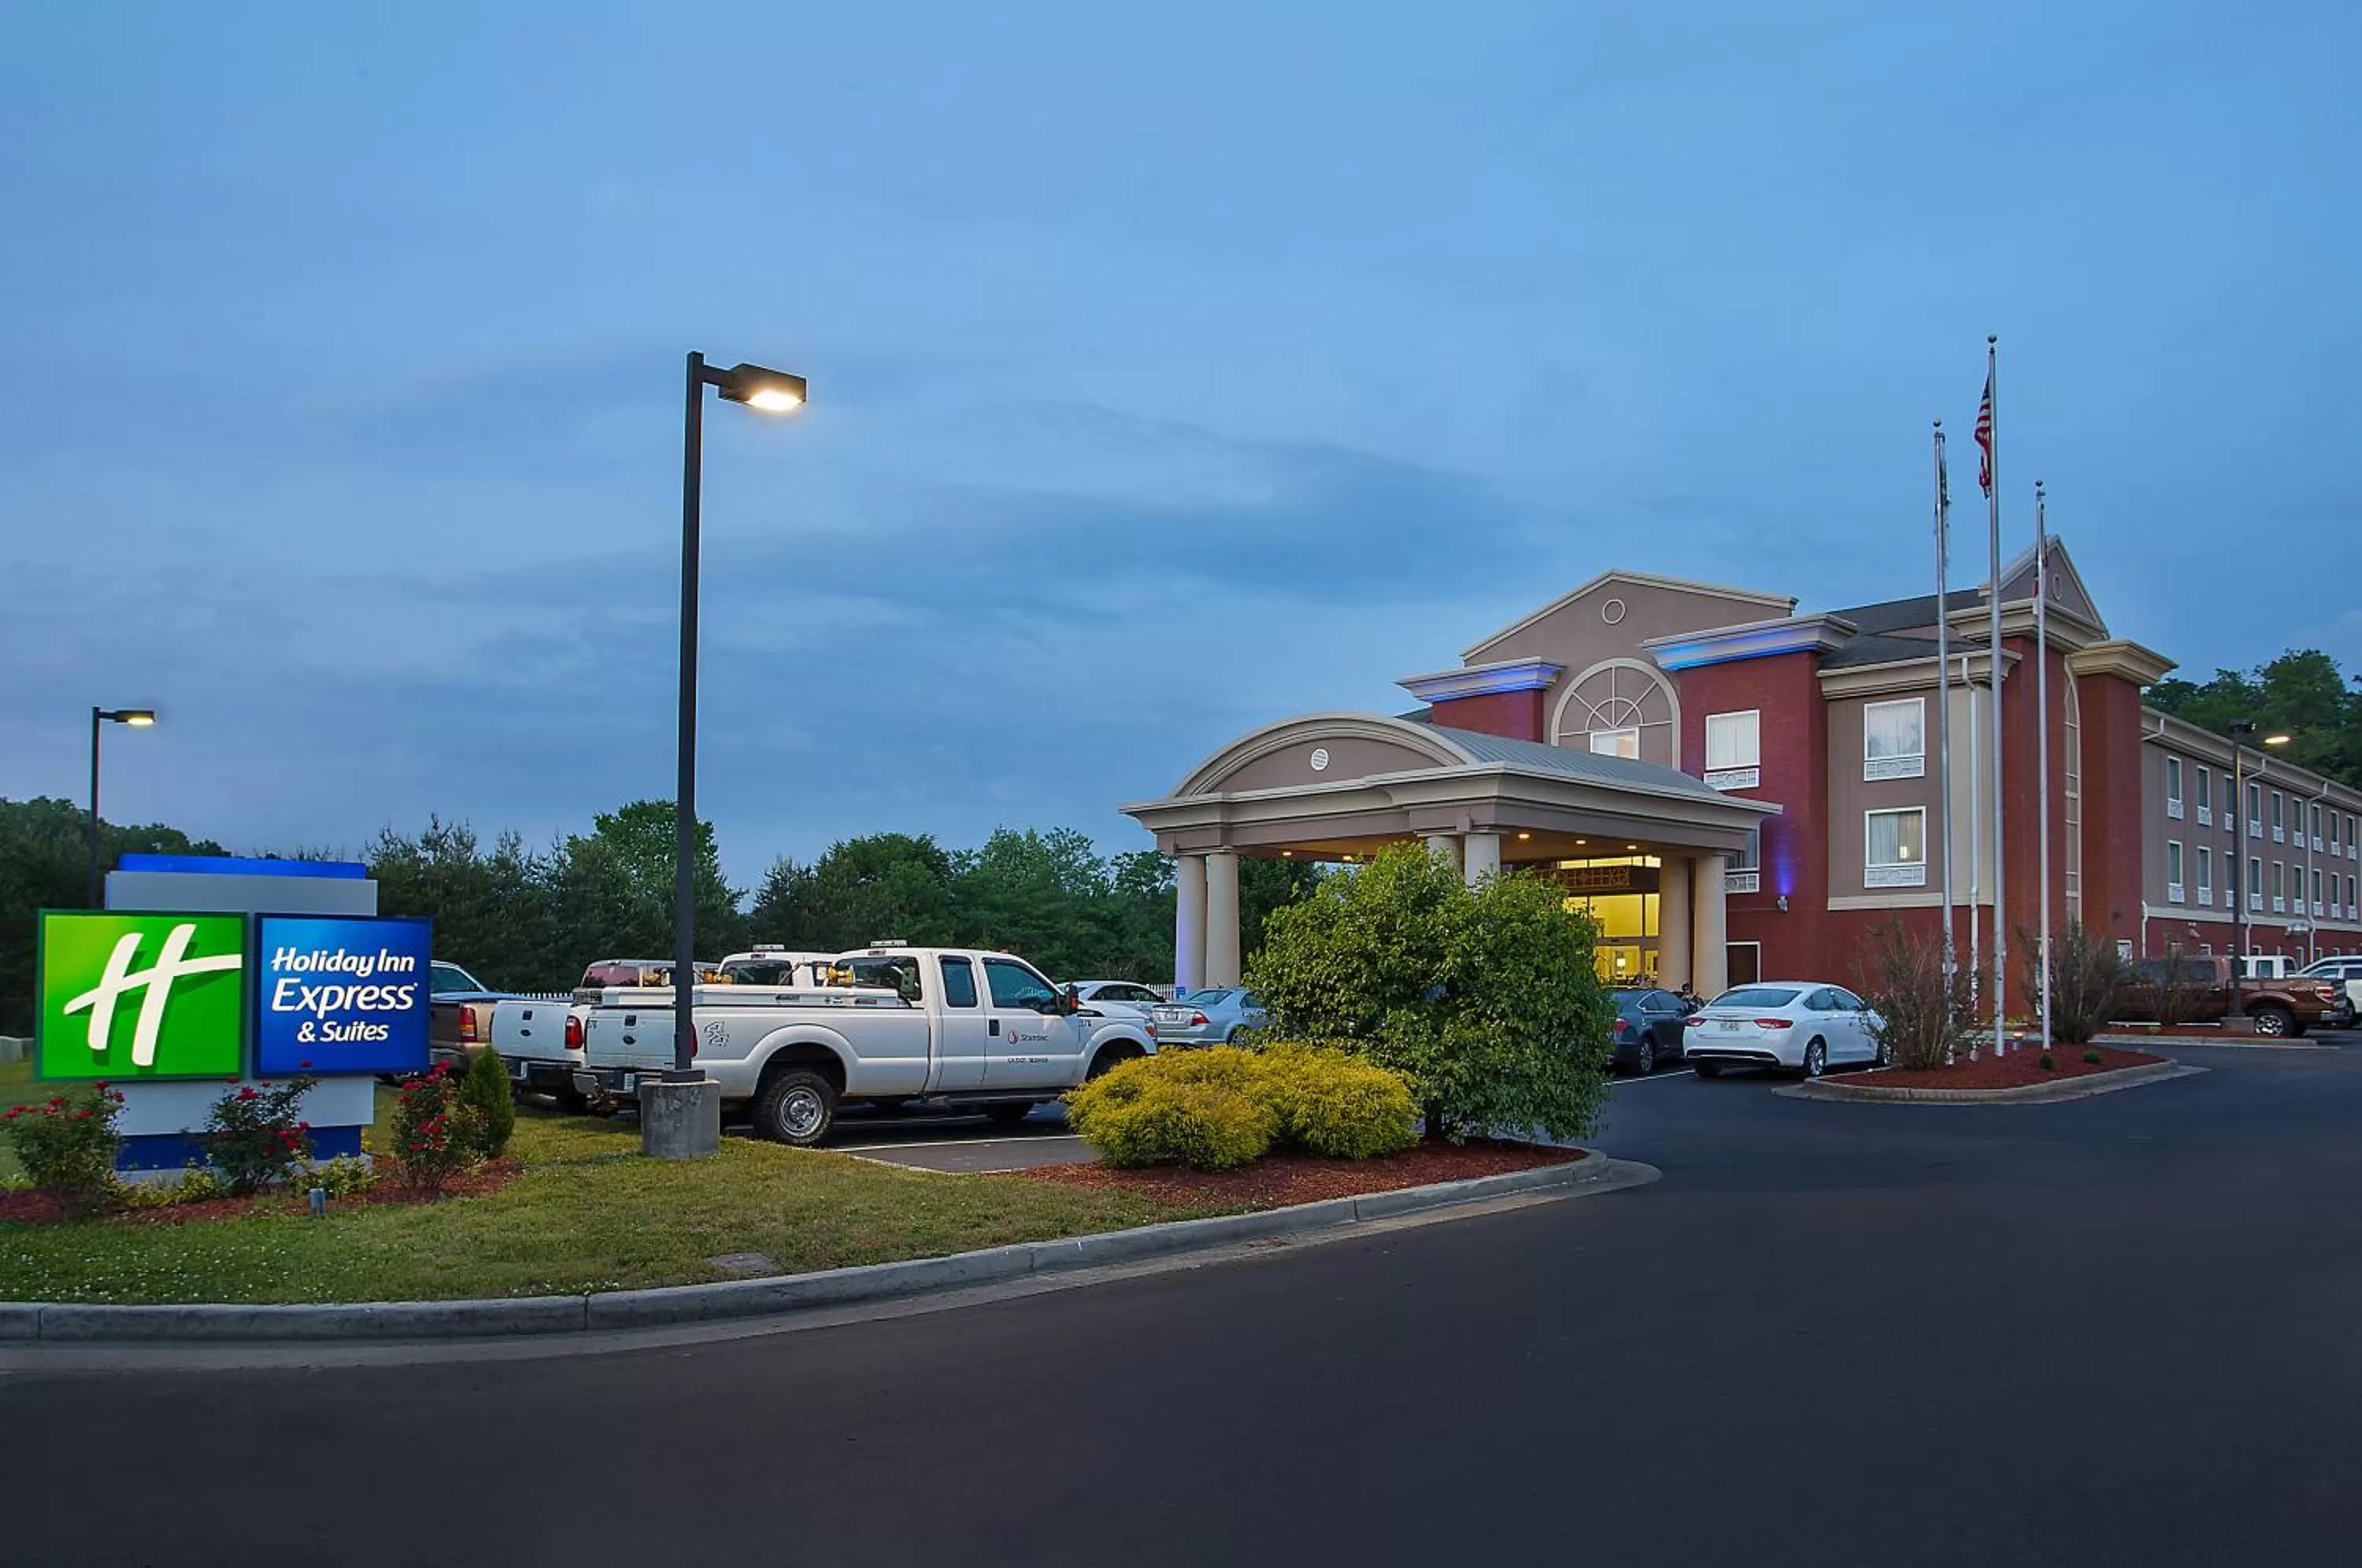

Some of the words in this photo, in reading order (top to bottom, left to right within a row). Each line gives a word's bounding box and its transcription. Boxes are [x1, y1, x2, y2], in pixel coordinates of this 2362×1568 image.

[271, 947, 375, 977] Holiday
[377, 949, 414, 972] Inn
[272, 977, 415, 1019] Express
[297, 1021, 315, 1042] &
[320, 1021, 389, 1041] Suites
